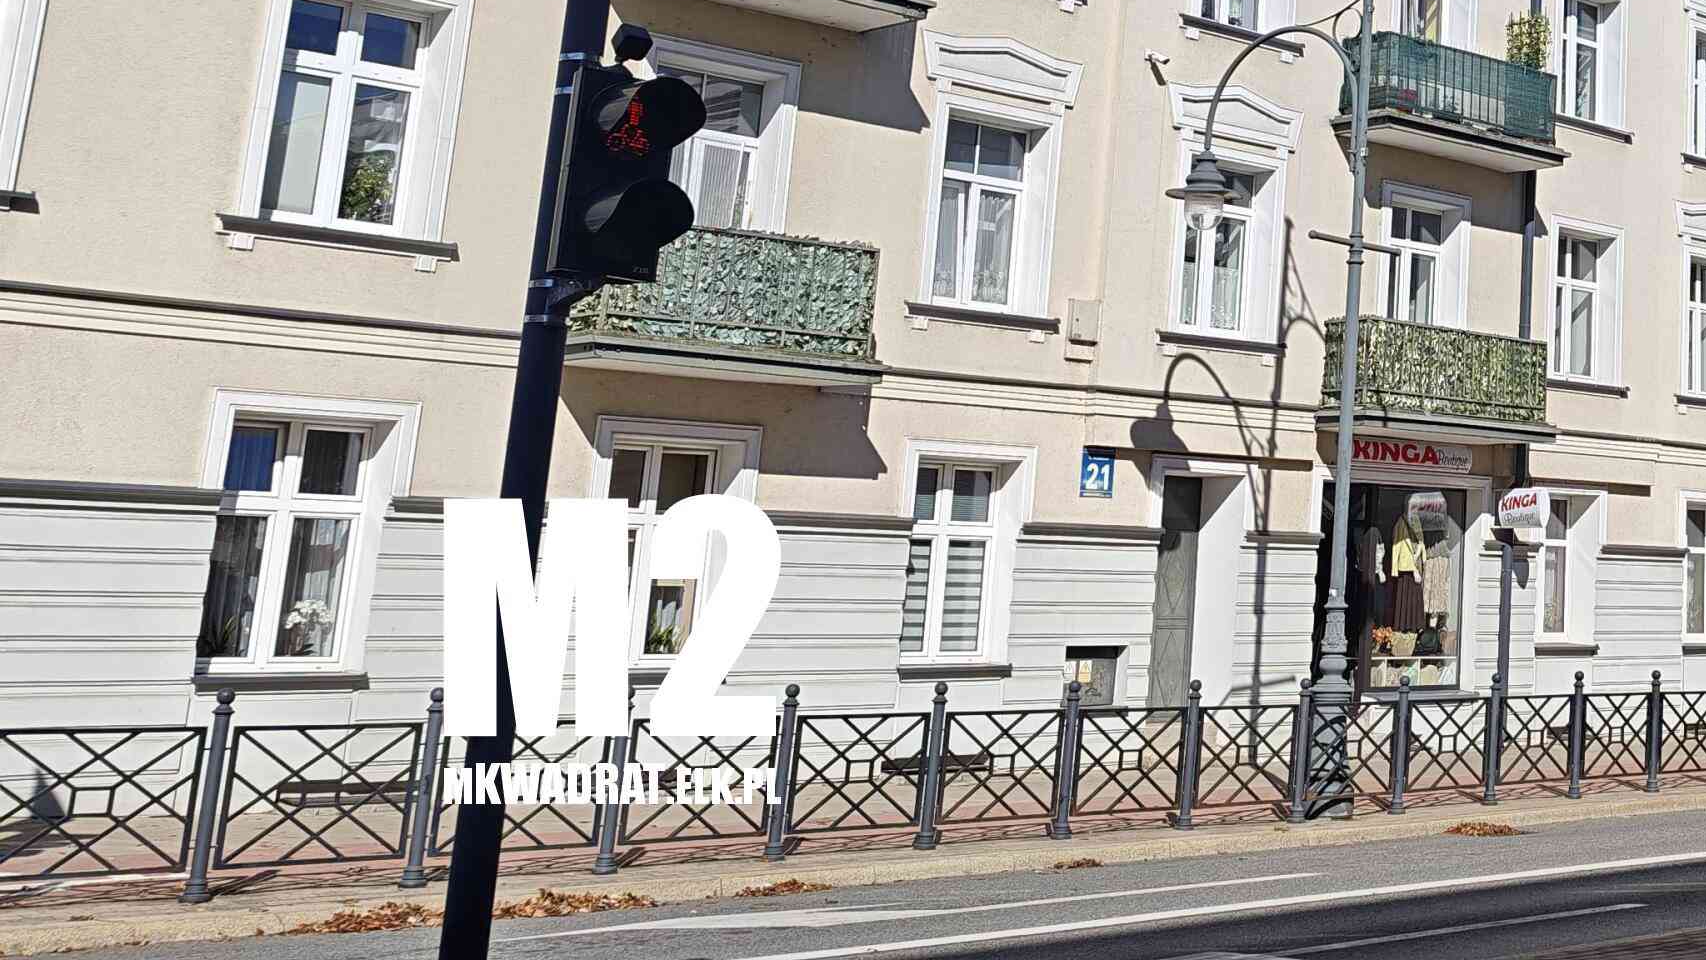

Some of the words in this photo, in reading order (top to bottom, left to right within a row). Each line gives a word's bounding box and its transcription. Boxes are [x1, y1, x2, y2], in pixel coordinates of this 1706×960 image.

[1352, 438, 1440, 465] KINGA
[1085, 463, 1110, 490] 21
[1500, 492, 1538, 512] KINGA
